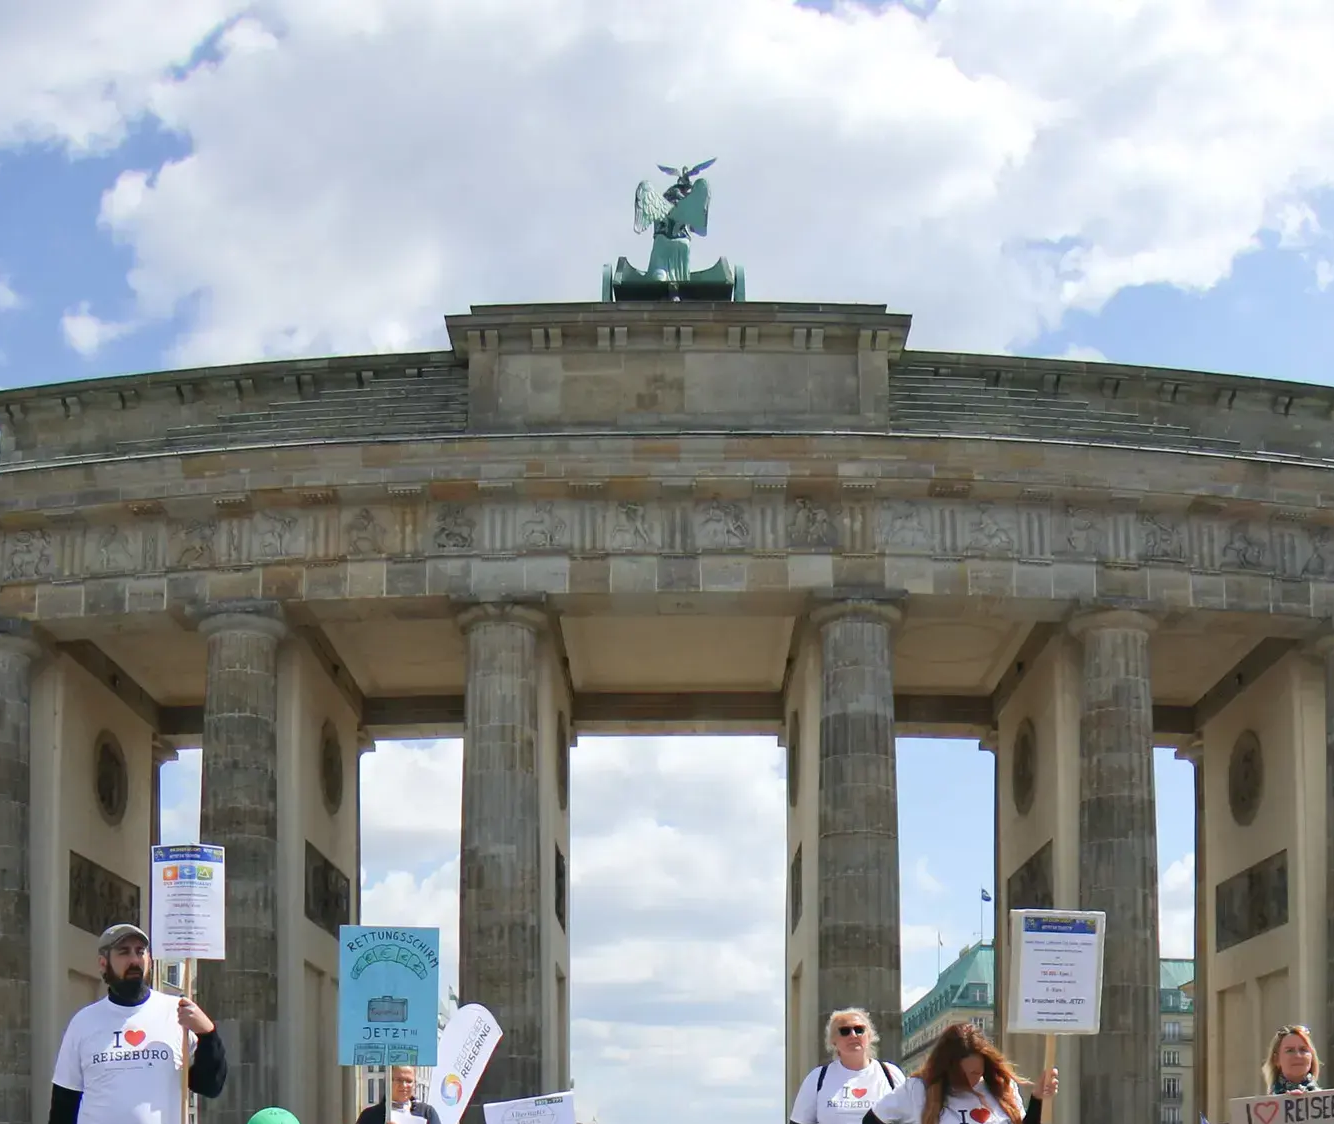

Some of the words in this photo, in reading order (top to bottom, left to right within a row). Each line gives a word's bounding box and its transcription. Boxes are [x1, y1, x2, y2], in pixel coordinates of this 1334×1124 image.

[347, 930, 440, 969] RETTUNGSSCHIRM
[113, 1030, 123, 1048] I
[452, 1015, 485, 1073] DEUTSCHER
[460, 1024, 492, 1079] REISERING
[92, 1048, 169, 1065] REISEBÜRO
[842, 1086, 850, 1099] I
